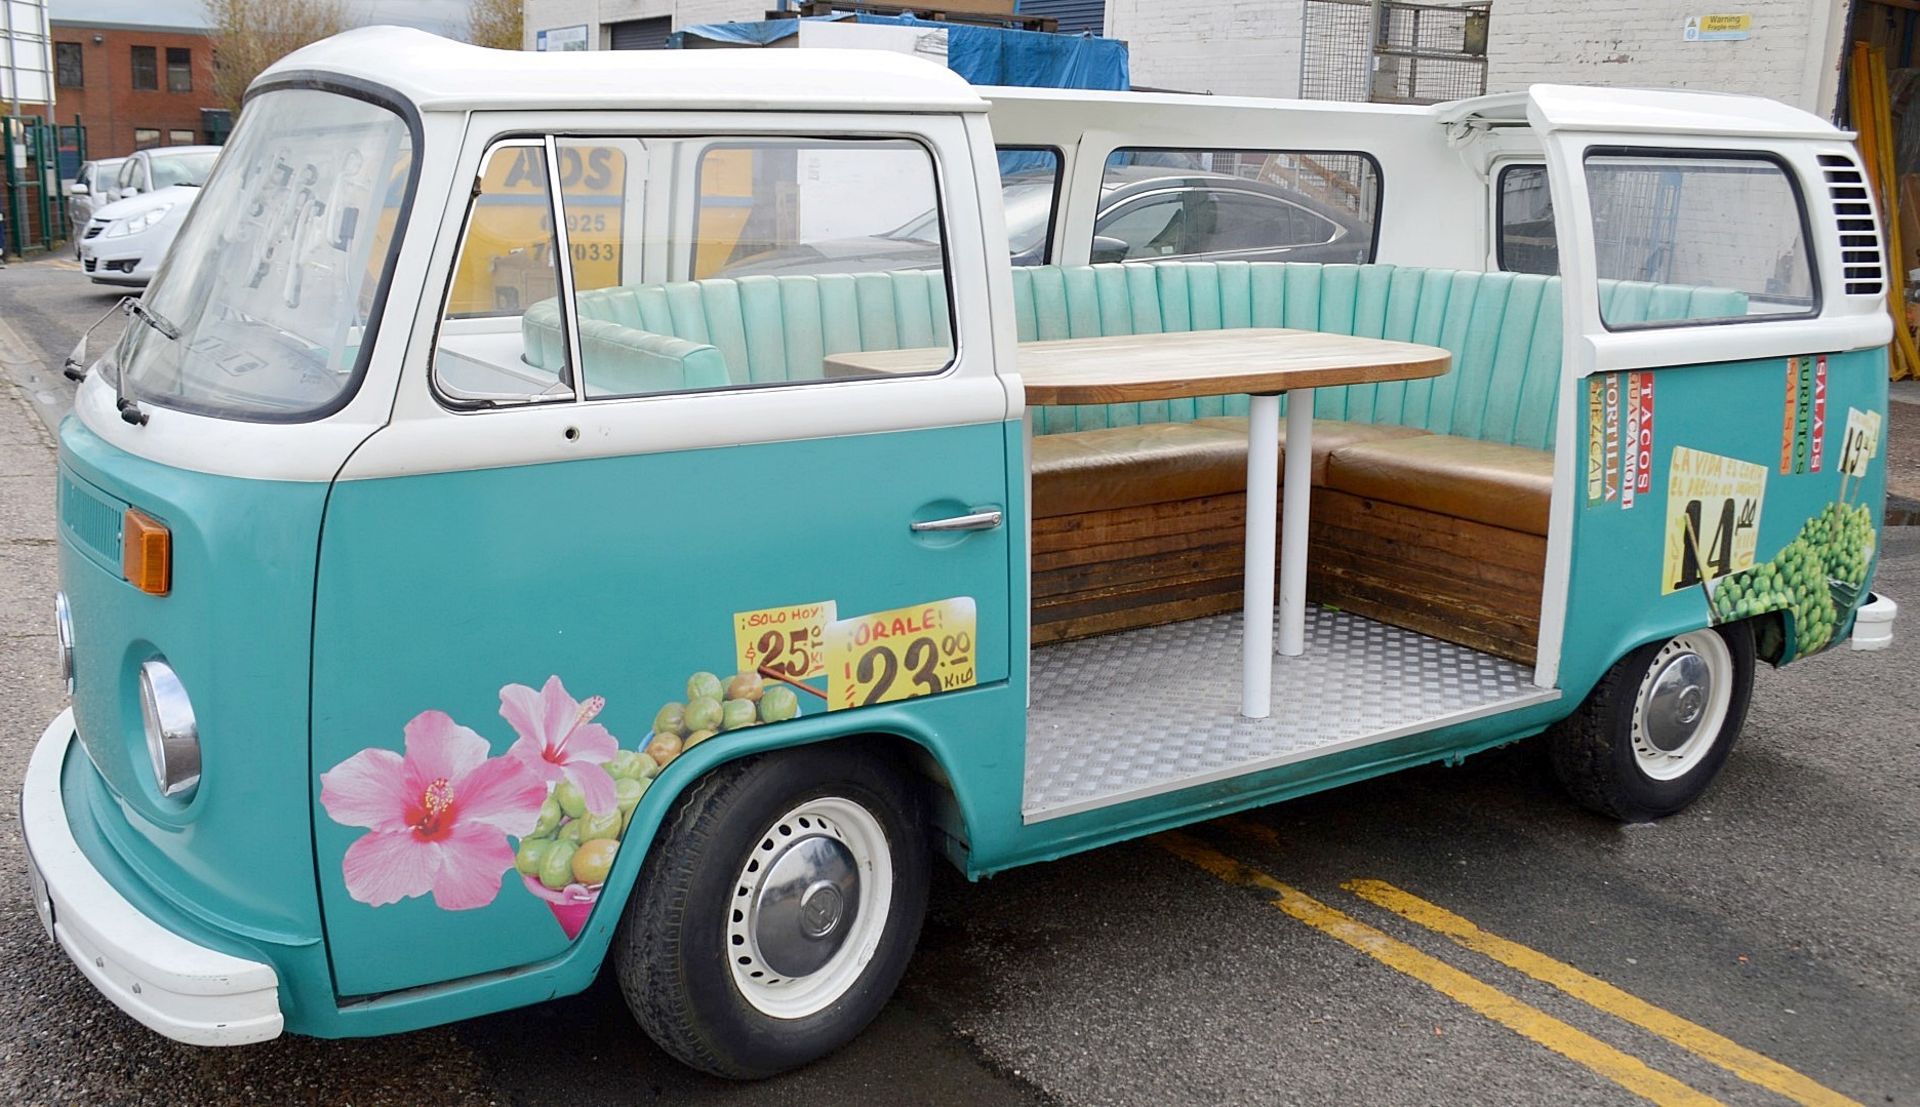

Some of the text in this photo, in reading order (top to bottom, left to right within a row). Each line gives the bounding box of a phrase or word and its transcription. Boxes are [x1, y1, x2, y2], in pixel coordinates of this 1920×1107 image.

[1709, 15, 1741, 25] Warning
[532, 243, 614, 261] 7033
[1589, 387, 1604, 492] MEZCAL
[1604, 373, 1619, 502] TORTILLA
[1637, 383, 1653, 489] TACOS
[1781, 361, 1798, 471] SALSAS
[1811, 361, 1826, 470] SALADS
[944, 667, 974, 689] KILO
